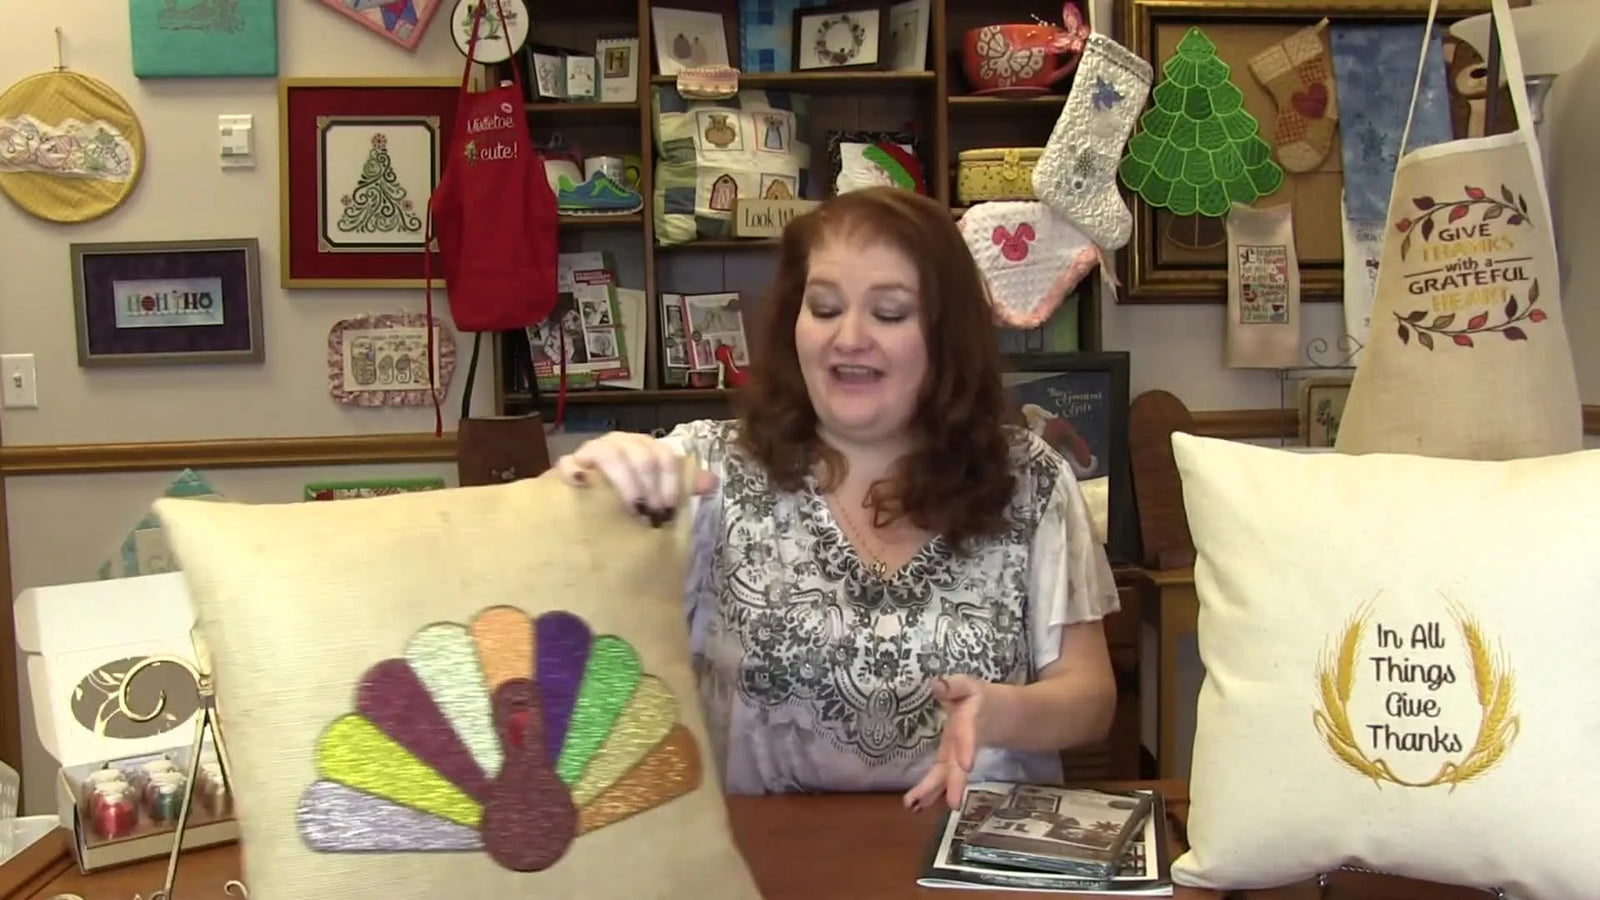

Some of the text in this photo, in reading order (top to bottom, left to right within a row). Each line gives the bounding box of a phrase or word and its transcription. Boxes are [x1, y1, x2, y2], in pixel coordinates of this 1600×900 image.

[480, 141, 518, 160] cute!
[745, 206, 774, 228] Look
[1438, 223, 1492, 242] GIVE
[1444, 257, 1493, 272] with a
[1408, 266, 1530, 295] GRATEFUL
[1377, 621, 1446, 649] In All
[1369, 655, 1457, 691] Things
[1385, 691, 1442, 718] Give
[1365, 723, 1463, 753] Thanks
